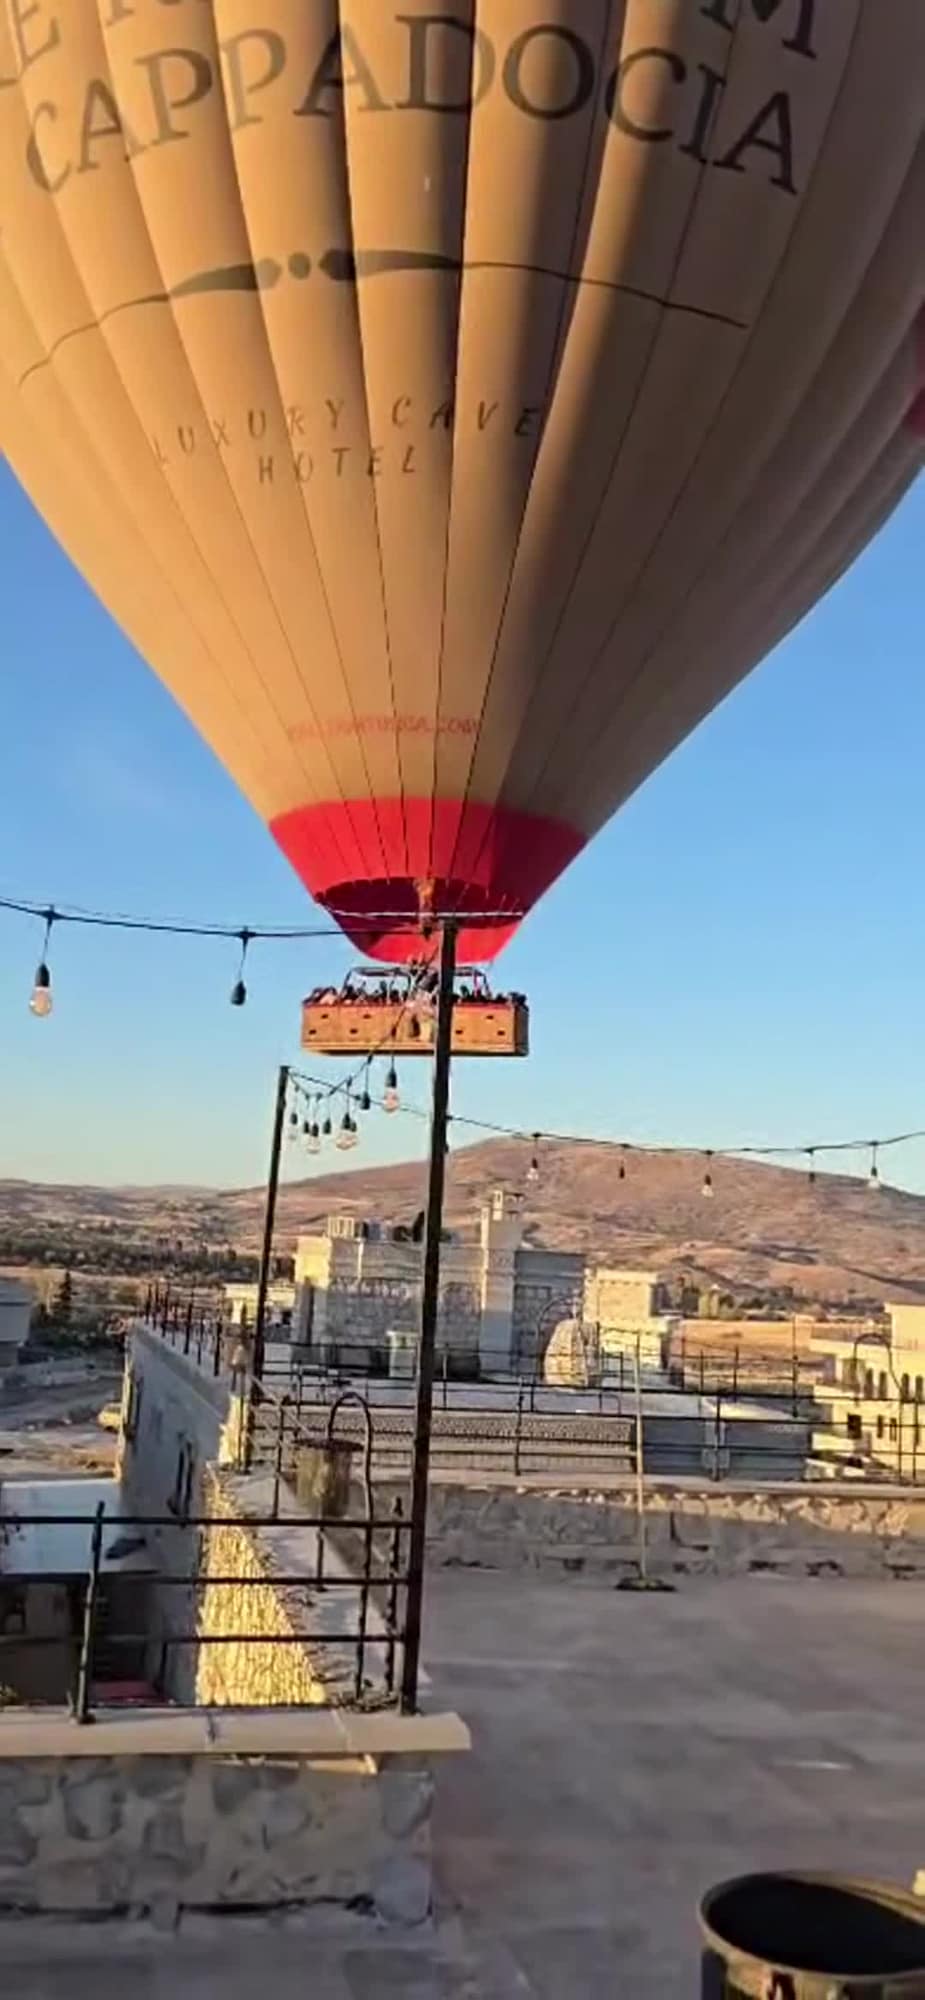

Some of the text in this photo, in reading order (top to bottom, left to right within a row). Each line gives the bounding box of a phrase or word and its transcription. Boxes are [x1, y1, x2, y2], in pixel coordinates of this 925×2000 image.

[26, 15, 798, 195] CAPPADOCIA
[152, 396, 540, 464] LUXURY CAVE
[258, 445, 417, 485] HOTEL
